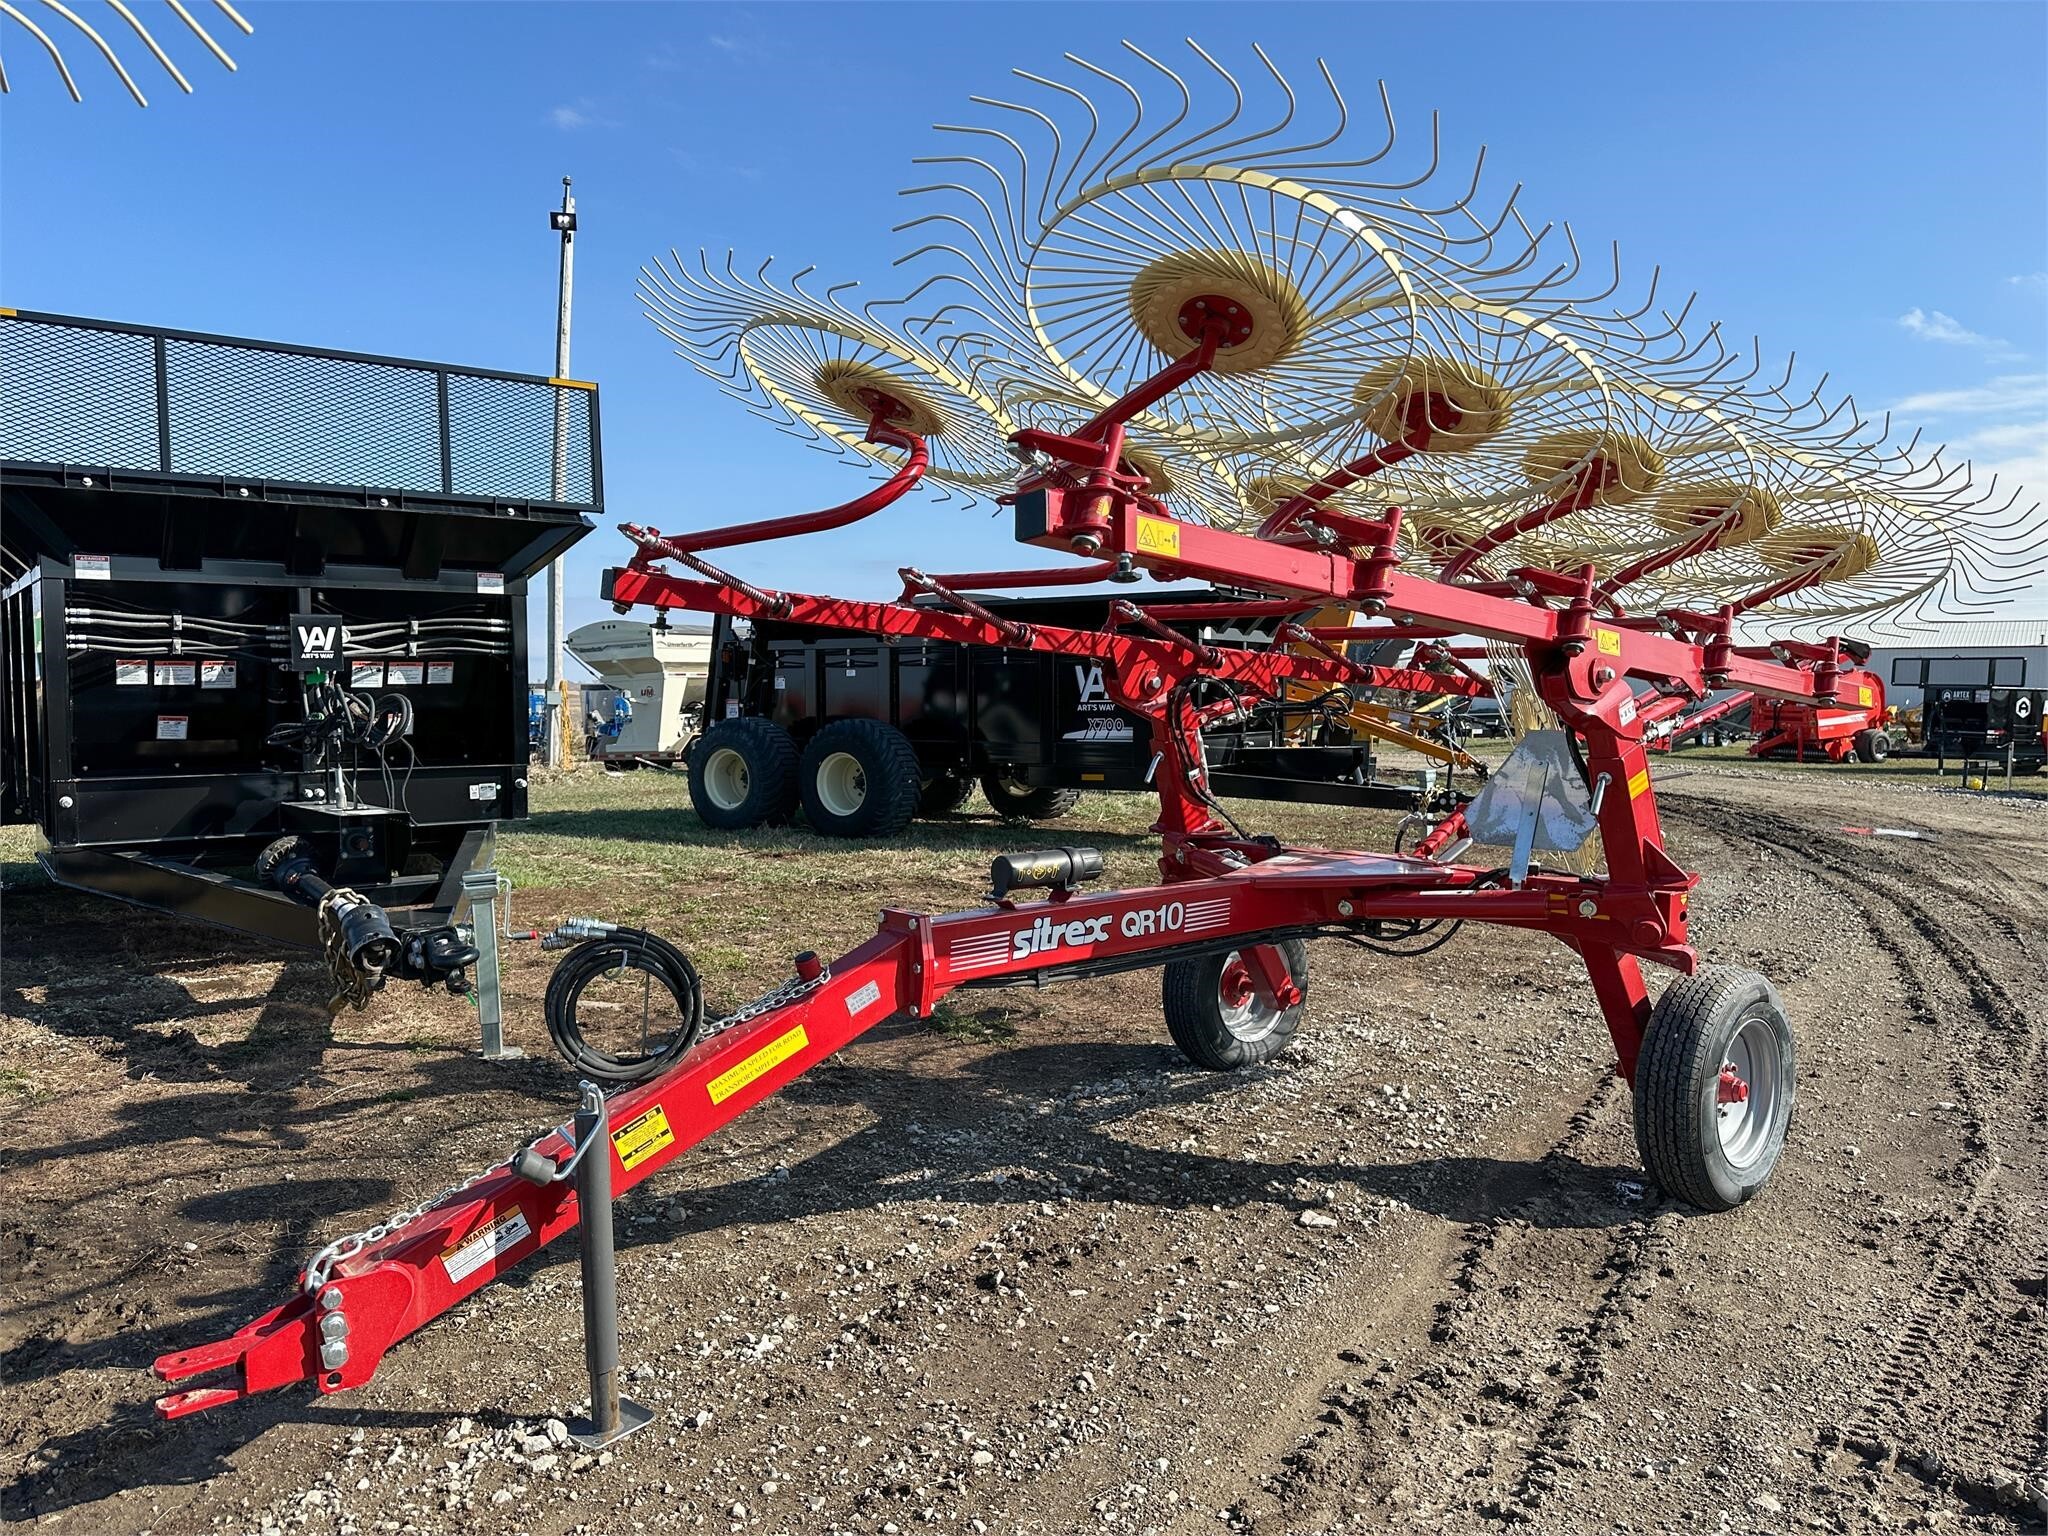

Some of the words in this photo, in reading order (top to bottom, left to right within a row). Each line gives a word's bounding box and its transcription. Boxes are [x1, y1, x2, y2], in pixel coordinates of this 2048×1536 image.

[1088, 718, 1124, 732] X700
[1012, 916, 1113, 960] sitrex
[1121, 902, 1184, 938] QR10
[711, 1063, 747, 1091] MAXIMUM
[748, 1050, 769, 1067] SPEED
[769, 1042, 783, 1055] FOR
[783, 1030, 802, 1046] ROAD
[715, 1072, 754, 1099] TRANSPORT
[753, 1060, 771, 1075] MPH
[464, 1214, 507, 1245] WARNING
